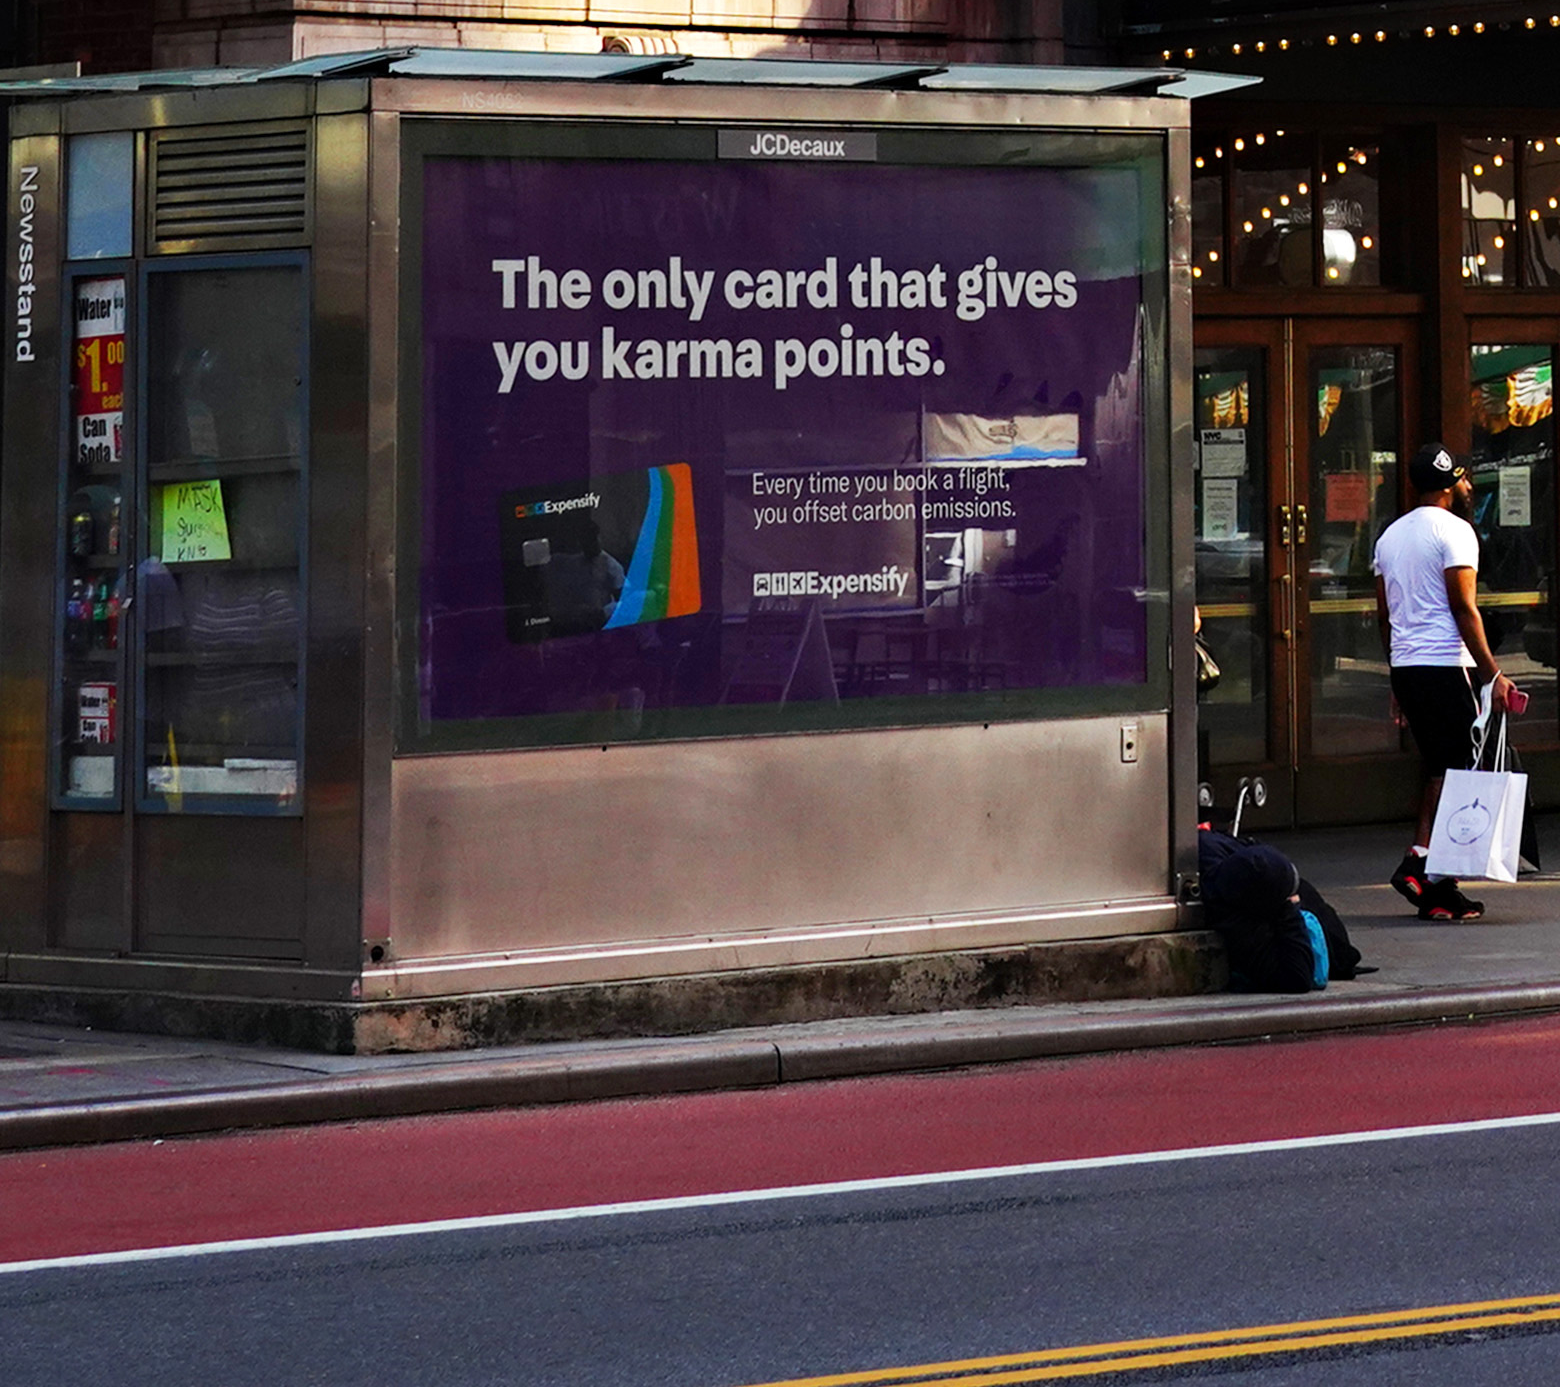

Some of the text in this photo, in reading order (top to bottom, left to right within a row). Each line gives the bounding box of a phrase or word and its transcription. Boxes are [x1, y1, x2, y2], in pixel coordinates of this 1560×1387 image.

[750, 133, 845, 157] JCDecaux
[16, 165, 40, 362] Newsstand
[492, 256, 1078, 321] The only card that gives
[78, 297, 112, 322] Water
[492, 323, 946, 394] you karma points.
[82, 415, 108, 439] Can
[1204, 431, 1222, 441] NYC
[79, 442, 111, 465] Soda
[752, 467, 1011, 499] Every time you book a flight,
[544, 492, 601, 514] Expensify
[754, 497, 1017, 530] you offset carbon emissions.
[806, 565, 909, 599] Expensify
